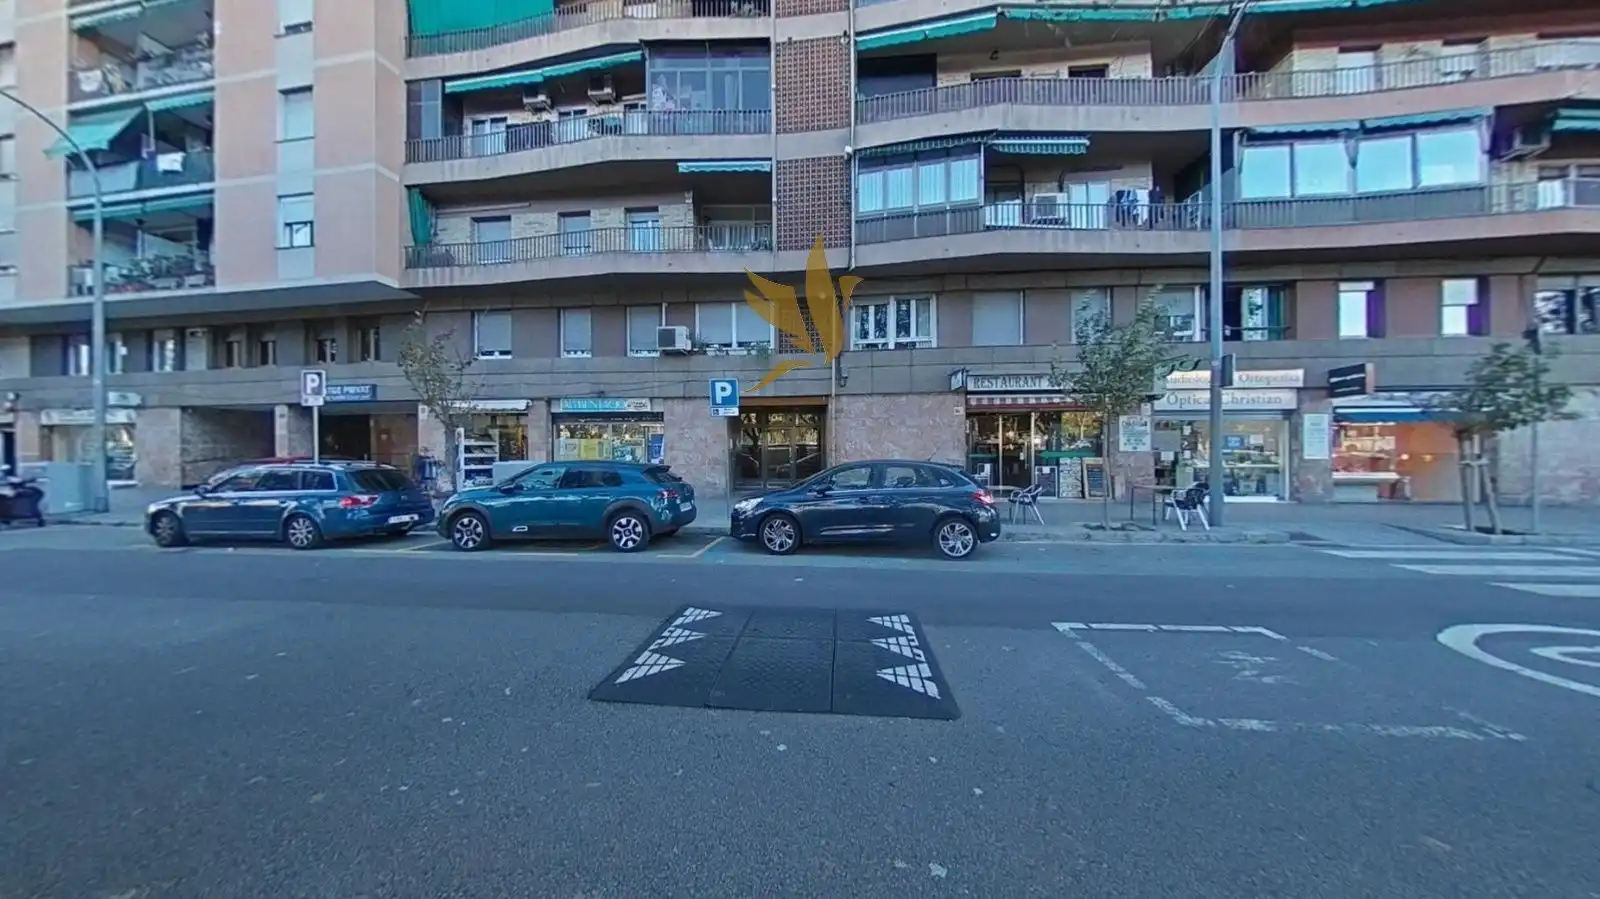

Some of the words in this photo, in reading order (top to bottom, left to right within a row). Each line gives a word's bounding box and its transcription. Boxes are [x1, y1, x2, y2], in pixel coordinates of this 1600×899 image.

[306, 374, 320, 394] P
[973, 375, 1045, 389] RESTAURANT
[715, 381, 732, 404] P
[1221, 391, 1283, 405] Christian
